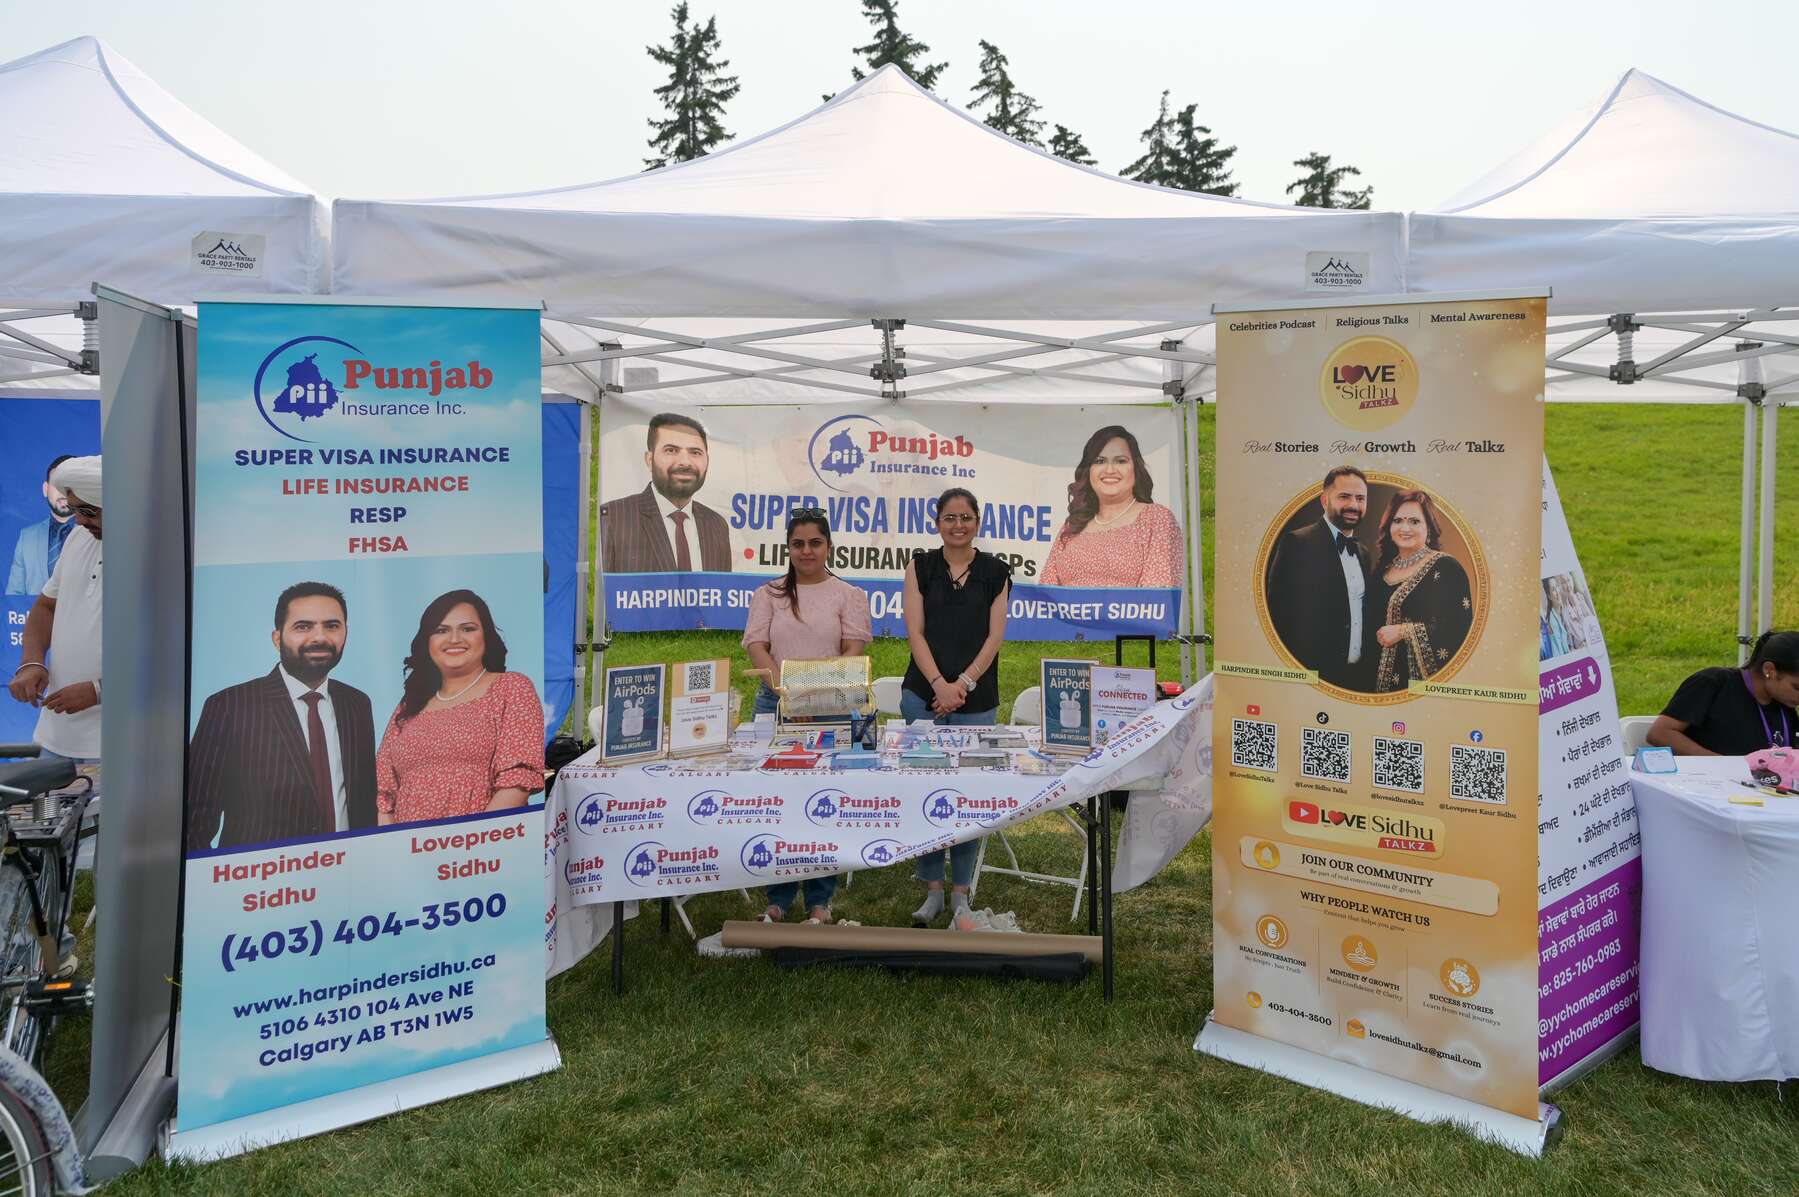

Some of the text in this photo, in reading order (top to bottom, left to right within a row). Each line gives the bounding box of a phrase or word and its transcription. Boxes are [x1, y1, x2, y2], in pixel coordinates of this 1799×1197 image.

[1335, 314, 1409, 328] Religious Talks
[1430, 311, 1526, 323] Mental Awareness
[1229, 319, 1316, 333] Celebrities Podcast
[342, 359, 494, 397] Punjab
[1341, 384, 1397, 401] Sidhu
[341, 401, 467, 416] Insurance Inc.
[1363, 399, 1394, 409] TALKZ
[867, 430, 974, 461] Punjab
[1243, 440, 1320, 454] Real Stories
[1329, 440, 1416, 454] Real Growth
[1427, 439, 1505, 454] Real Talkz
[234, 446, 510, 467] SUPER VISA INSURANCE
[869, 460, 976, 479] Insurance Inc
[282, 475, 470, 496] LIFE INSURANCE
[350, 506, 407, 524] RESP
[828, 495, 889, 534] VISA
[898, 496, 1052, 542] INSANCE
[348, 535, 408, 553] FHSA
[759, 543, 790, 566] LIF
[616, 588, 753, 609] HARPINDER SID
[1006, 599, 1165, 620] OVEPREET SIDHU
[614, 673, 656, 686] ENTER TO WIN
[1049, 667, 1067, 676] ENTER
[1068, 668, 1076, 677] TO
[1221, 664, 1307, 680] HARPINDER SINGH SIDHU
[613, 683, 656, 698] AirPods
[1049, 677, 1090, 690] AirPods
[1098, 689, 1148, 701] CONNECTED
[1425, 684, 1527, 700] LOVEPREET KAUR SIDHU
[605, 797, 667, 812] Punjab
[721, 795, 784, 809] Punjab
[838, 796, 901, 811] Punjab
[955, 796, 1018, 811] Punjab
[1578, 802, 1590, 816] 24
[605, 811, 665, 824] Insurance Inc.
[720, 807, 782, 818] Insurance Inc.
[839, 810, 901, 819] Insurance Inc.
[602, 822, 665, 834] CALGARY
[717, 817, 782, 826] CALGARY
[1371, 814, 1434, 842] Sidhu
[410, 821, 526, 855] Lovepreet
[1384, 839, 1426, 851] TALKZ
[657, 845, 719, 864] Punjab
[775, 840, 839, 855] Punjab
[212, 850, 346, 883] Harpinder
[775, 855, 838, 866] Insurance Inc.
[436, 858, 501, 882] Sidhu
[658, 863, 719, 875] Insurance Inc.
[775, 866, 840, 876] CALGARY
[1301, 853, 1434, 889] JOIN OUR COMMUNITY
[657, 875, 721, 886] CALGARY
[242, 887, 317, 913] Sidhu
[1300, 890, 1431, 927] WHY PEOPLE WATCH US
[220, 919, 324, 973] (403)
[333, 892, 507, 945] 404-3500
[1239, 944, 1307, 968] REAL CONVERSATIONS
[1553, 938, 1621, 990] 825-760-0983
[232, 953, 496, 1019] www.harpindersidhu.ca
[1329, 967, 1360, 982] MINDSET
[1368, 977, 1400, 992] GROWTH
[259, 981, 474, 1041] 5106 4310 104 Ave NE
[1428, 992, 1494, 1015] SUCCESS STORIES
[1267, 1001, 1332, 1027] 403-404-3500
[258, 1005, 474, 1067] Calgary AB T3N 1W5
[1369, 1029, 1482, 1069] lovesidhutalkz@gmail.com
